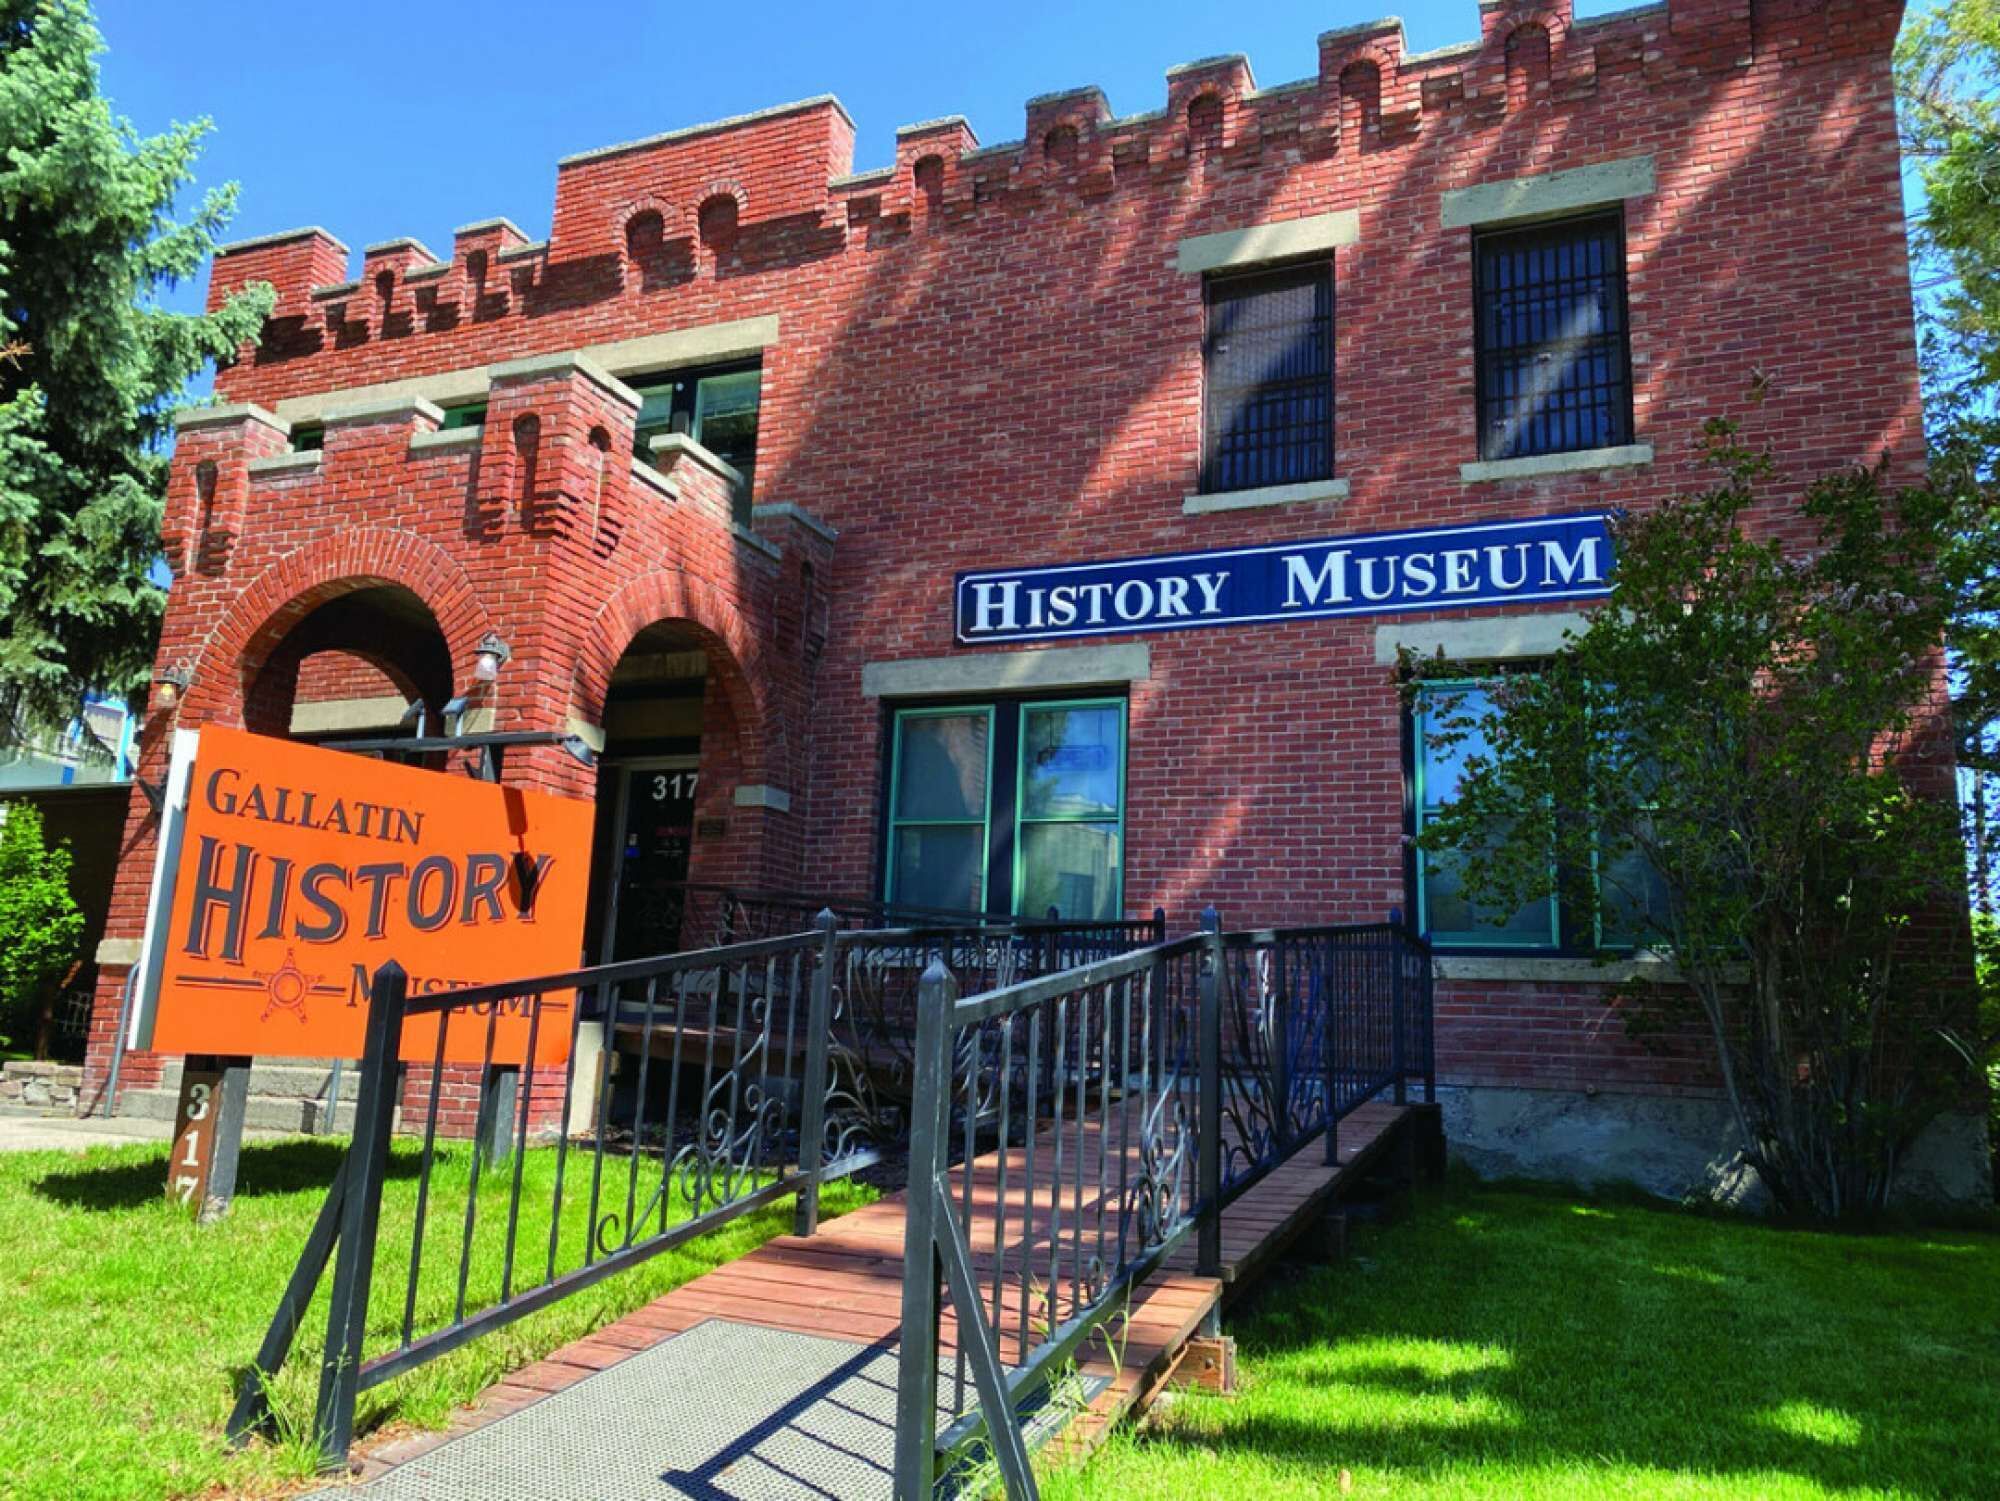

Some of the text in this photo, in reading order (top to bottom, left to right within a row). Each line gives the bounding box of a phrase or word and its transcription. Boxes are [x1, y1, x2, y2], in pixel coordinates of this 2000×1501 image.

[969, 536, 1602, 634] HISTORY MUSEUM
[205, 768, 425, 845] GALLATIN
[653, 774, 698, 801] 317
[182, 834, 554, 967] HISTORY
